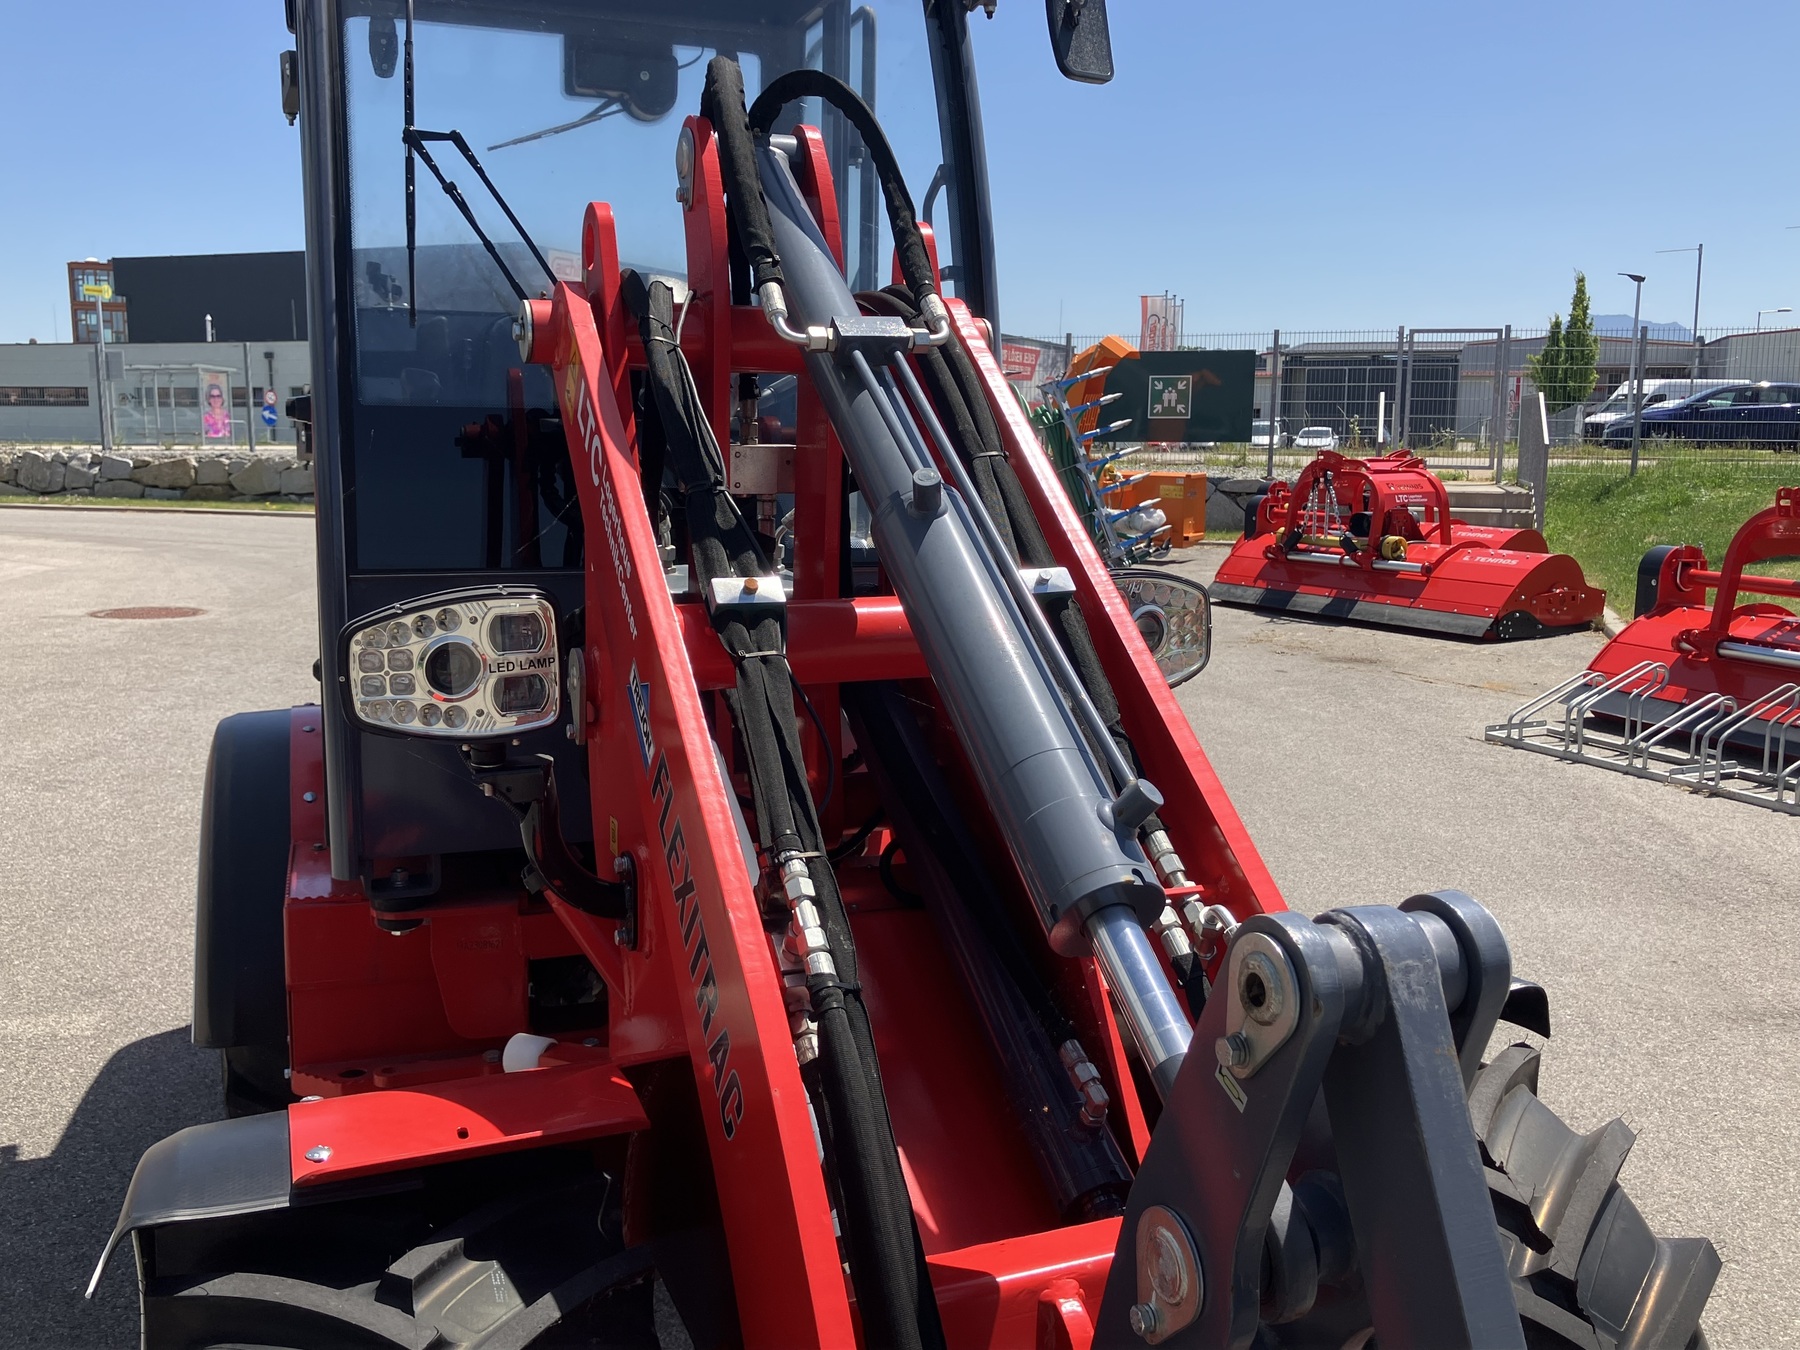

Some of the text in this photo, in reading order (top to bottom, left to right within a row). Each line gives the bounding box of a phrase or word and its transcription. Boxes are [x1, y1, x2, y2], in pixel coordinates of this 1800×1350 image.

[577, 378, 603, 487] LTC
[602, 464, 631, 579] Lagerhaus
[1394, 494, 1409, 503] LTC
[1456, 531, 1494, 539] TEHNOS
[1474, 556, 1520, 566] TEHNOS
[488, 657, 556, 674] LED LAMP
[631, 667, 653, 755] TREJON
[651, 747, 745, 1141] FLEXITRAC
